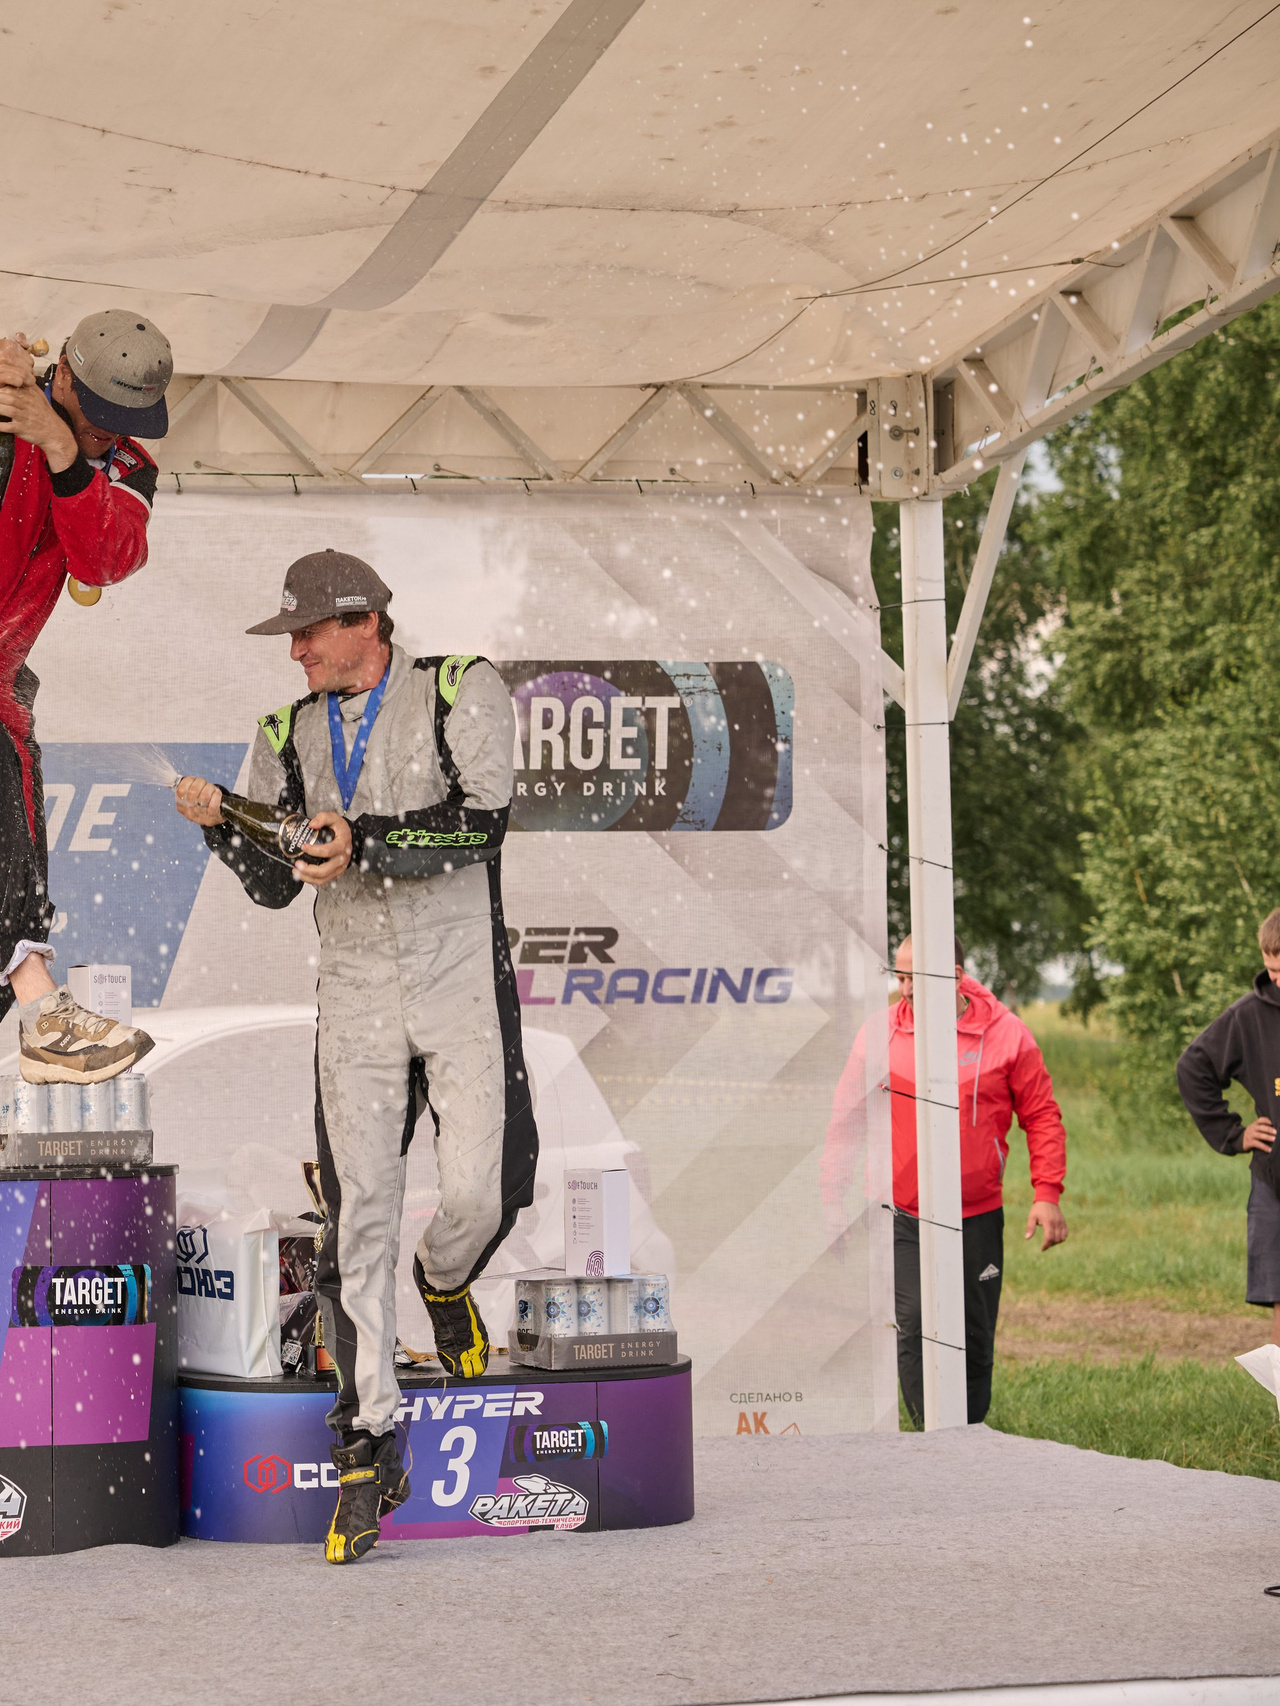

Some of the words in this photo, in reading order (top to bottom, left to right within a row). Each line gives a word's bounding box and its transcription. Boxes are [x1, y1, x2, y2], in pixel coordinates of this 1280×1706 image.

[510, 696, 681, 771] RGET
[517, 782, 565, 797] RGY
[583, 782, 667, 797] DRINK
[37, 1140, 83, 1156] TARGET
[90, 1139, 135, 1147] ENERGY
[90, 1148, 127, 1156] DRINK
[52, 1277, 126, 1306] TARGET
[176, 1266, 234, 1301] ОЮЗ
[573, 1343, 615, 1360] TARGET
[620, 1340, 662, 1349] ENERGY
[621, 1350, 655, 1358] DRINK
[393, 1391, 545, 1422] HYPER
[729, 1391, 792, 1404] СДЕЛАНО
[794, 1391, 803, 1402] В
[735, 1411, 771, 1436] АК
[533, 1429, 584, 1449] TARGET
[293, 1462, 341, 1488] СО
[431, 1425, 478, 1507] 3
[471, 1492, 587, 1519] РАКЕТА
[502, 1515, 586, 1526] СПОРТИВНО-ТЕХНИЧЕСКИЙ
